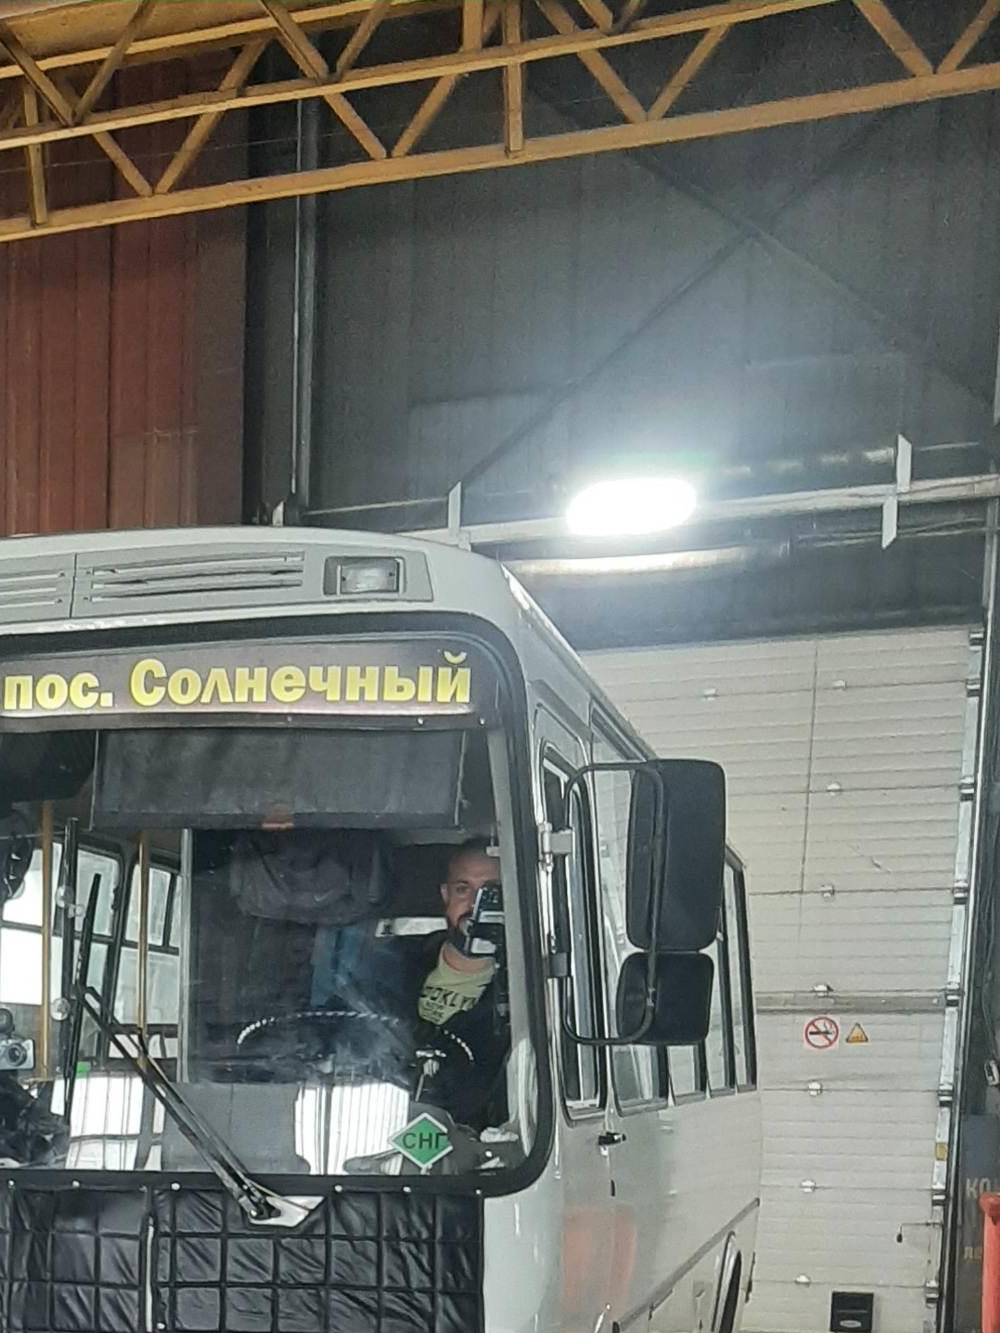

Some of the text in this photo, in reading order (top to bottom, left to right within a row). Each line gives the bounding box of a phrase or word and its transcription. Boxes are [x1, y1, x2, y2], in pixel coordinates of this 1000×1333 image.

[3, 649, 472, 710] пос. Солнечный
[402, 1132, 448, 1149] СНГ
